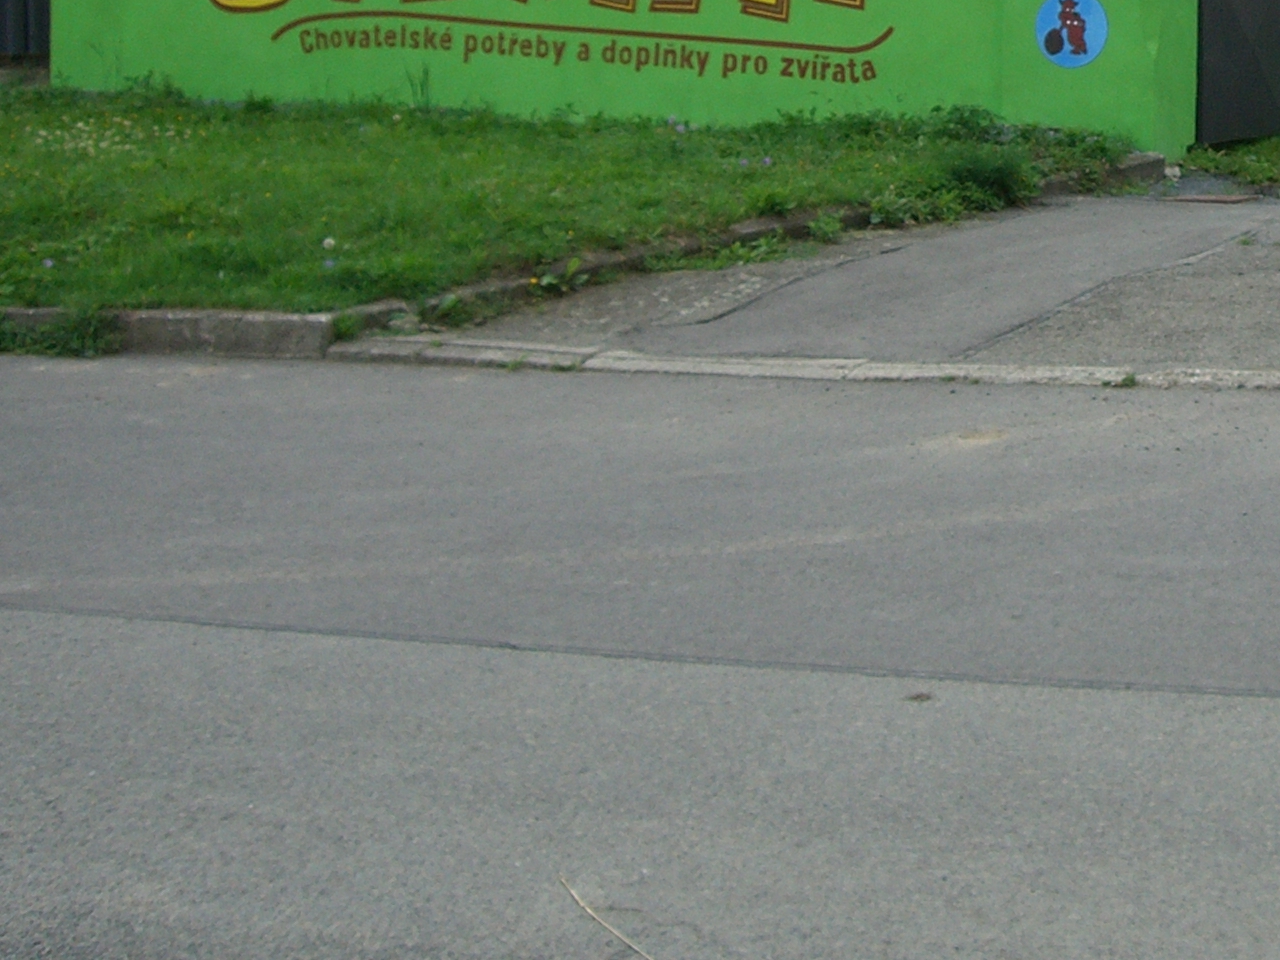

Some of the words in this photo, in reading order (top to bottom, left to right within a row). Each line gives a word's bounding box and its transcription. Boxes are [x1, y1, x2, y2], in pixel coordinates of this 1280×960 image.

[300, 25, 453, 54] Chovatelské
[463, 31, 566, 66] potřeby
[577, 43, 590, 62] a
[602, 39, 710, 77] doplňky
[722, 52, 768, 78] pro
[780, 54, 877, 84] zvířata
